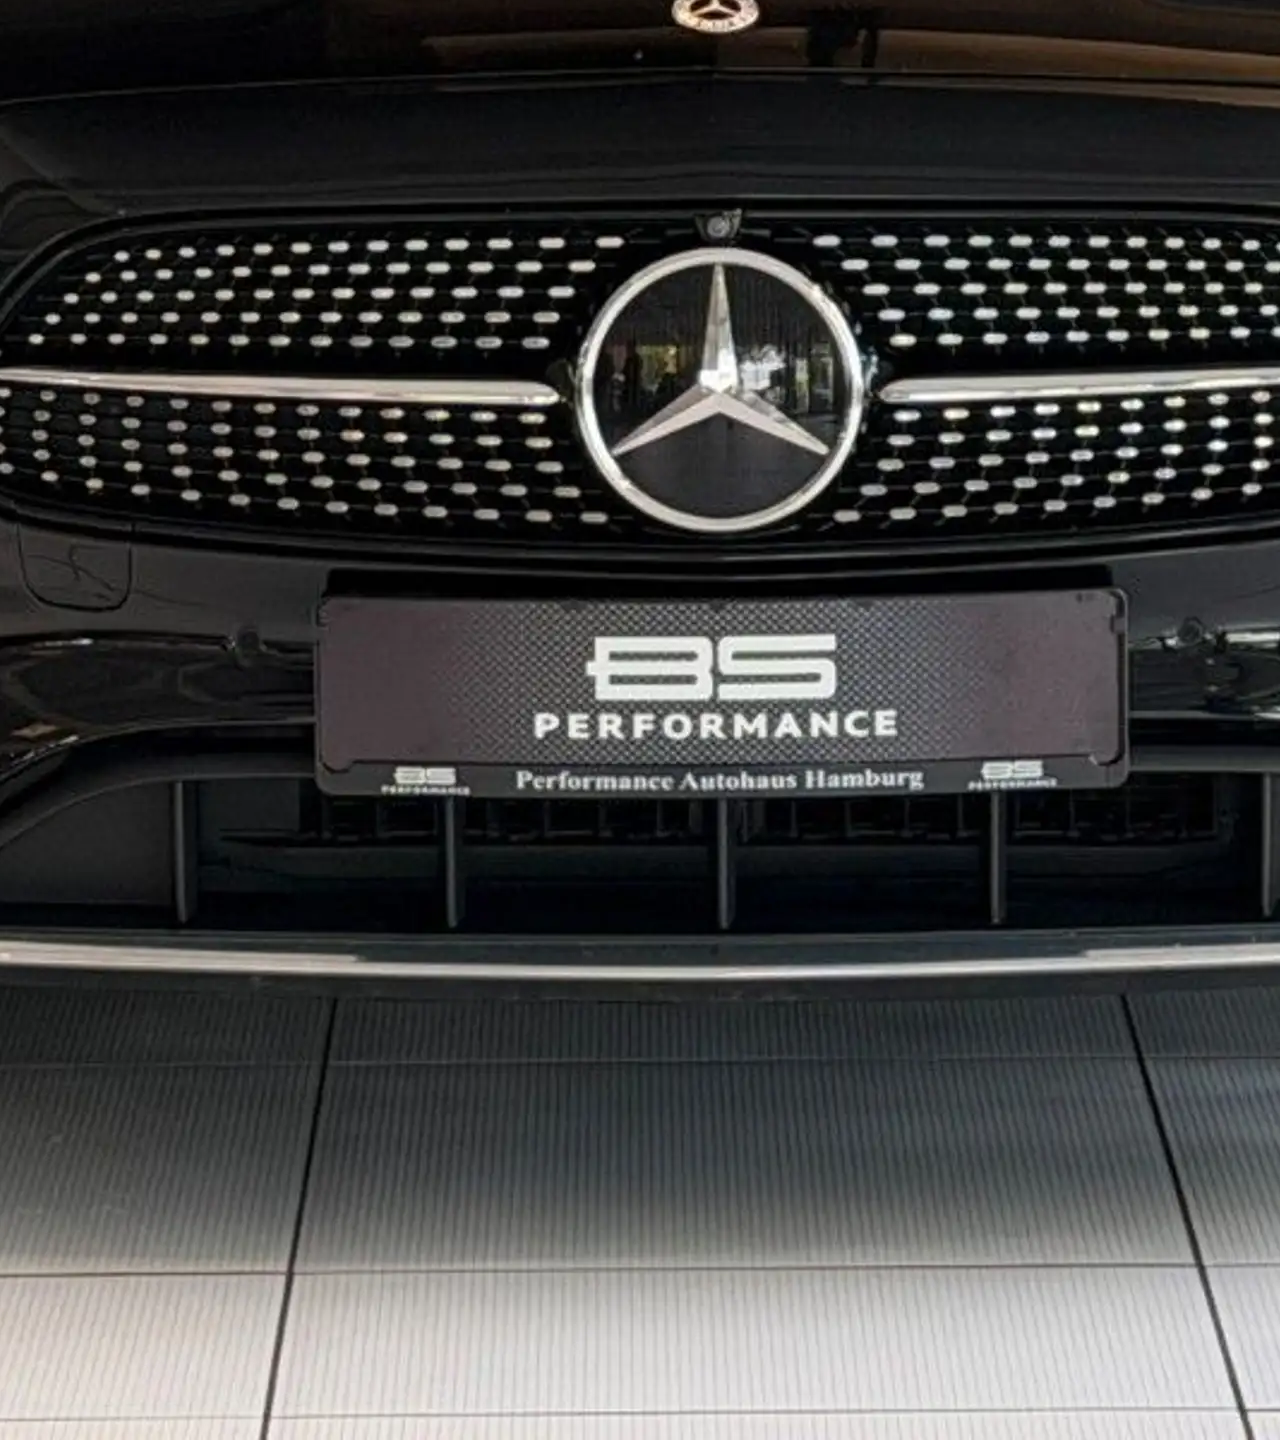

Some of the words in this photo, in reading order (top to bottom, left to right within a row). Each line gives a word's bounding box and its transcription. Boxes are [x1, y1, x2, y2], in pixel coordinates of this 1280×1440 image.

[585, 634, 837, 701] BS
[533, 709, 899, 740] PERFORMANCE
[515, 770, 674, 792] Performance
[678, 770, 797, 791] Autohaus
[805, 768, 924, 792] Hamburg
